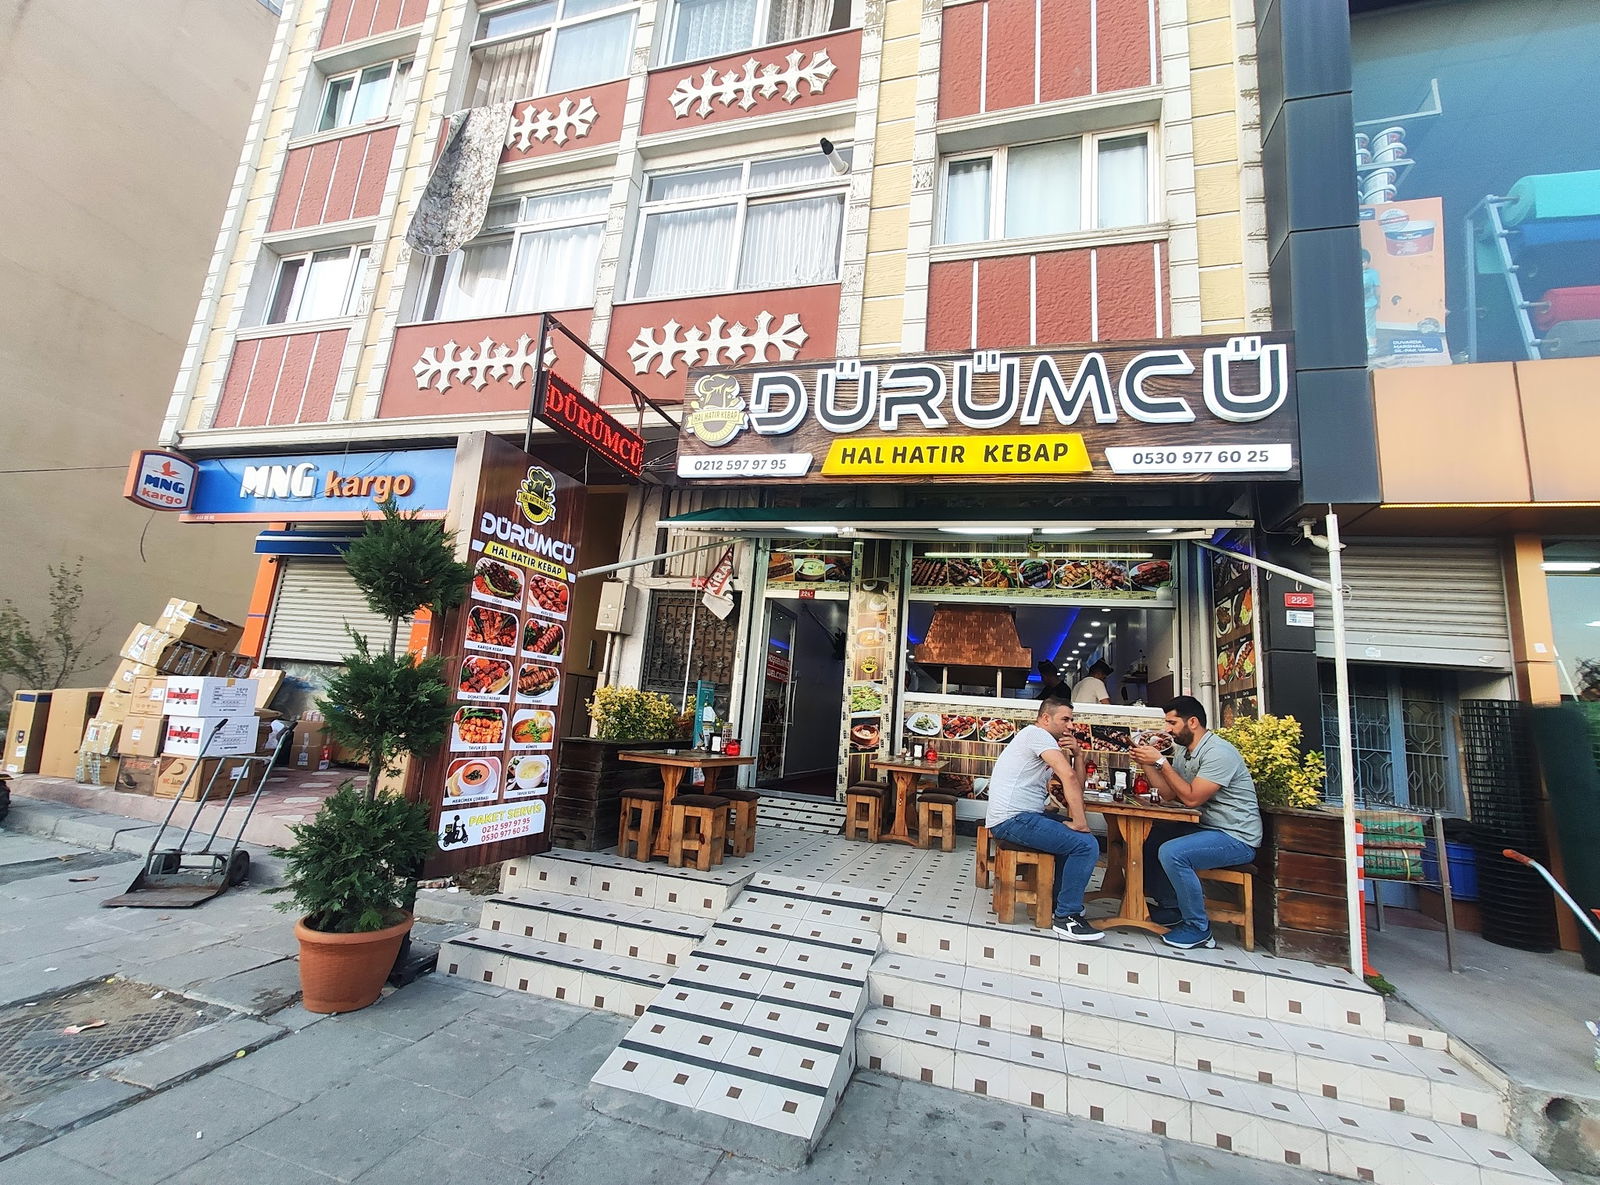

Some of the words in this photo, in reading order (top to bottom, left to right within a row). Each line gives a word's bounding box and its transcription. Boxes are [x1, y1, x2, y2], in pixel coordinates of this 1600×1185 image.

[749, 336, 1289, 434] DÜRÜMCÜ
[547, 384, 641, 466] DÜRÜMCÜ
[704, 410, 720, 419] HATIR
[721, 410, 738, 420] KEBAP
[840, 446, 885, 464] HAL
[891, 445, 965, 464] HATIR
[983, 442, 1069, 463] KEBAP
[1132, 452, 1178, 465] 0530
[1182, 452, 1214, 464] 977
[1218, 451, 1242, 464] 60
[1247, 450, 1269, 463] 25
[694, 460, 723, 471] 0212
[726, 460, 747, 470] 597
[752, 460, 766, 470] 97
[770, 459, 786, 470] 95
[144, 473, 185, 495] MNG
[239, 462, 319, 499] MNG
[324, 470, 415, 504] kargo
[142, 487, 182, 505] kargo
[480, 512, 575, 564] DÜRÜMCÜ
[492, 545, 508, 558] HAL
[512, 552, 536, 568] HATIR
[538, 560, 562, 576] KEBAP
[1290, 596, 1308, 604] 222
[468, 812, 504, 827] PAKET
[507, 802, 542, 820] SERVİS
[481, 832, 498, 842] 0530
[500, 829, 511, 838] 977
[512, 827, 520, 835] 60
[482, 824, 498, 834] 0212
[500, 820, 512, 830] 597
[513, 819, 521, 827] 97
